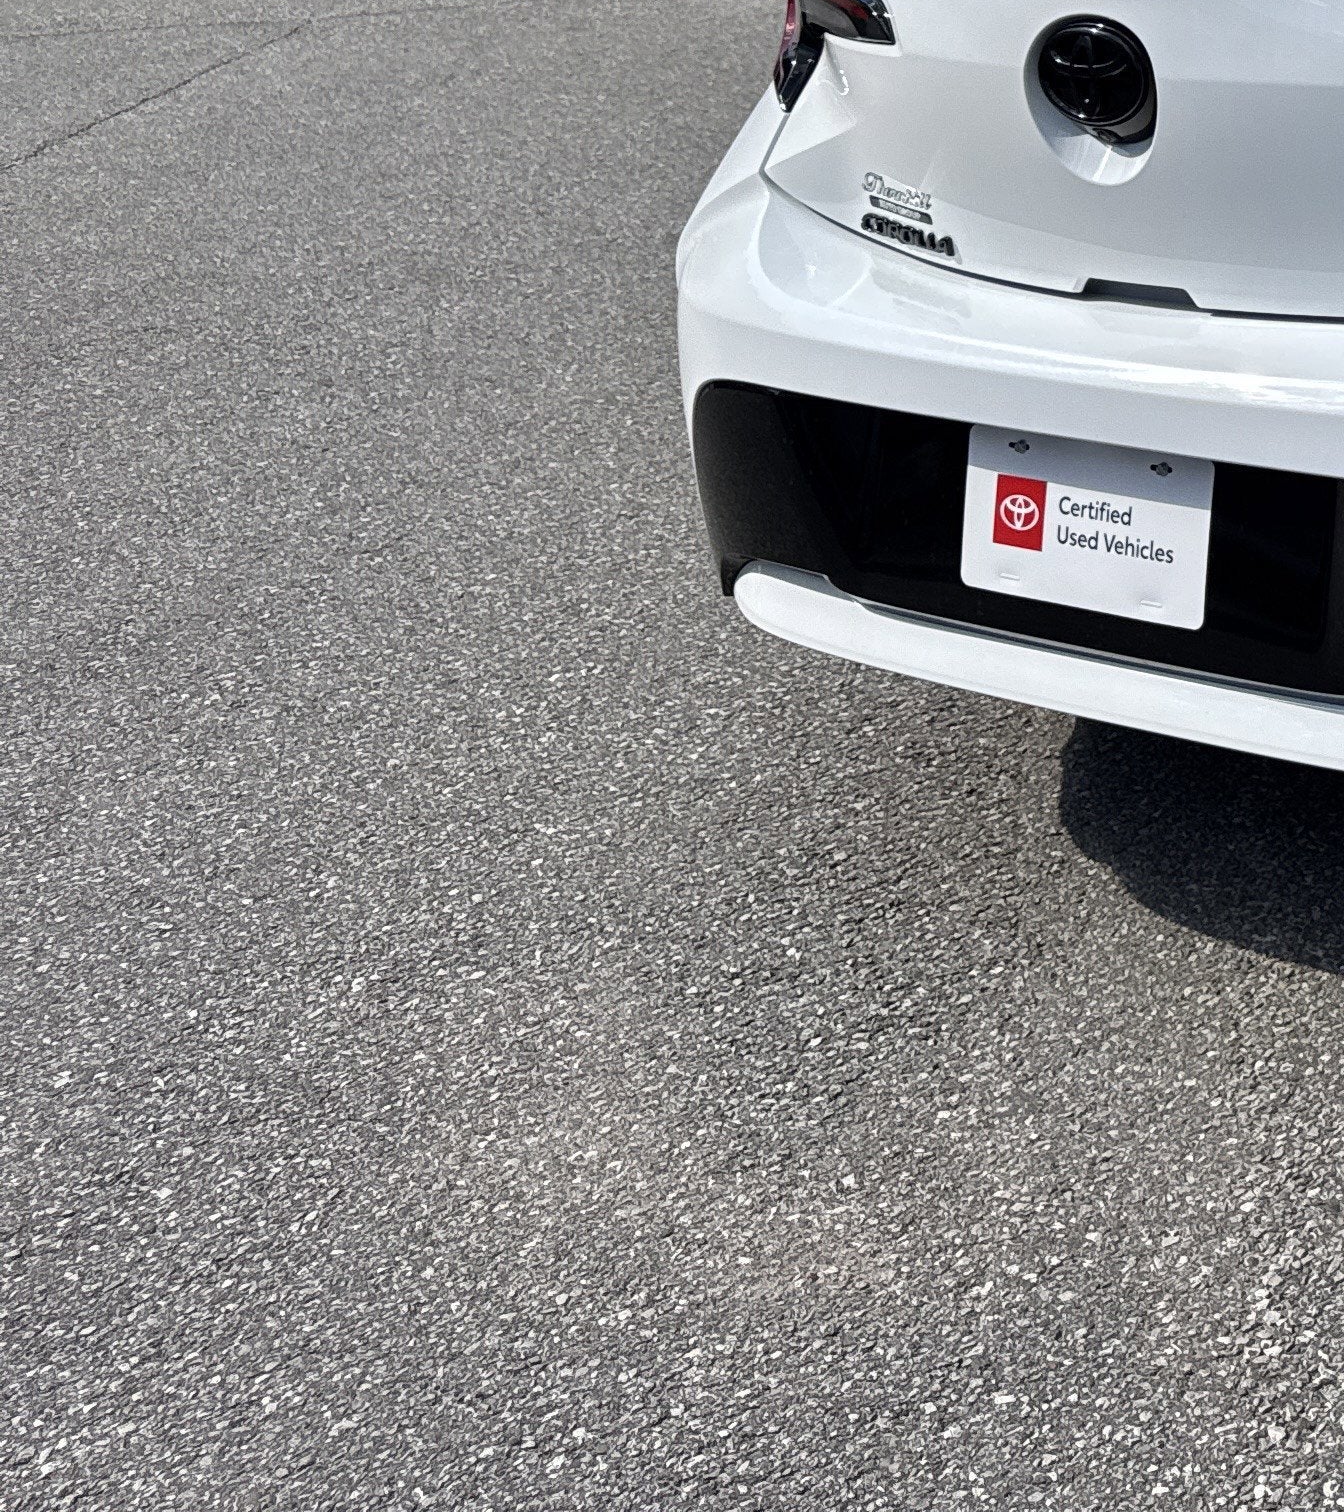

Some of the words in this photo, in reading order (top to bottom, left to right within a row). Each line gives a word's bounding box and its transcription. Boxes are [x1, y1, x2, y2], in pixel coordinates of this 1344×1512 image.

[861, 213, 955, 256] COROLLA
[1058, 496, 1133, 526] Certified
[1057, 524, 1100, 550] Used
[1103, 533, 1174, 564] Vehicles
